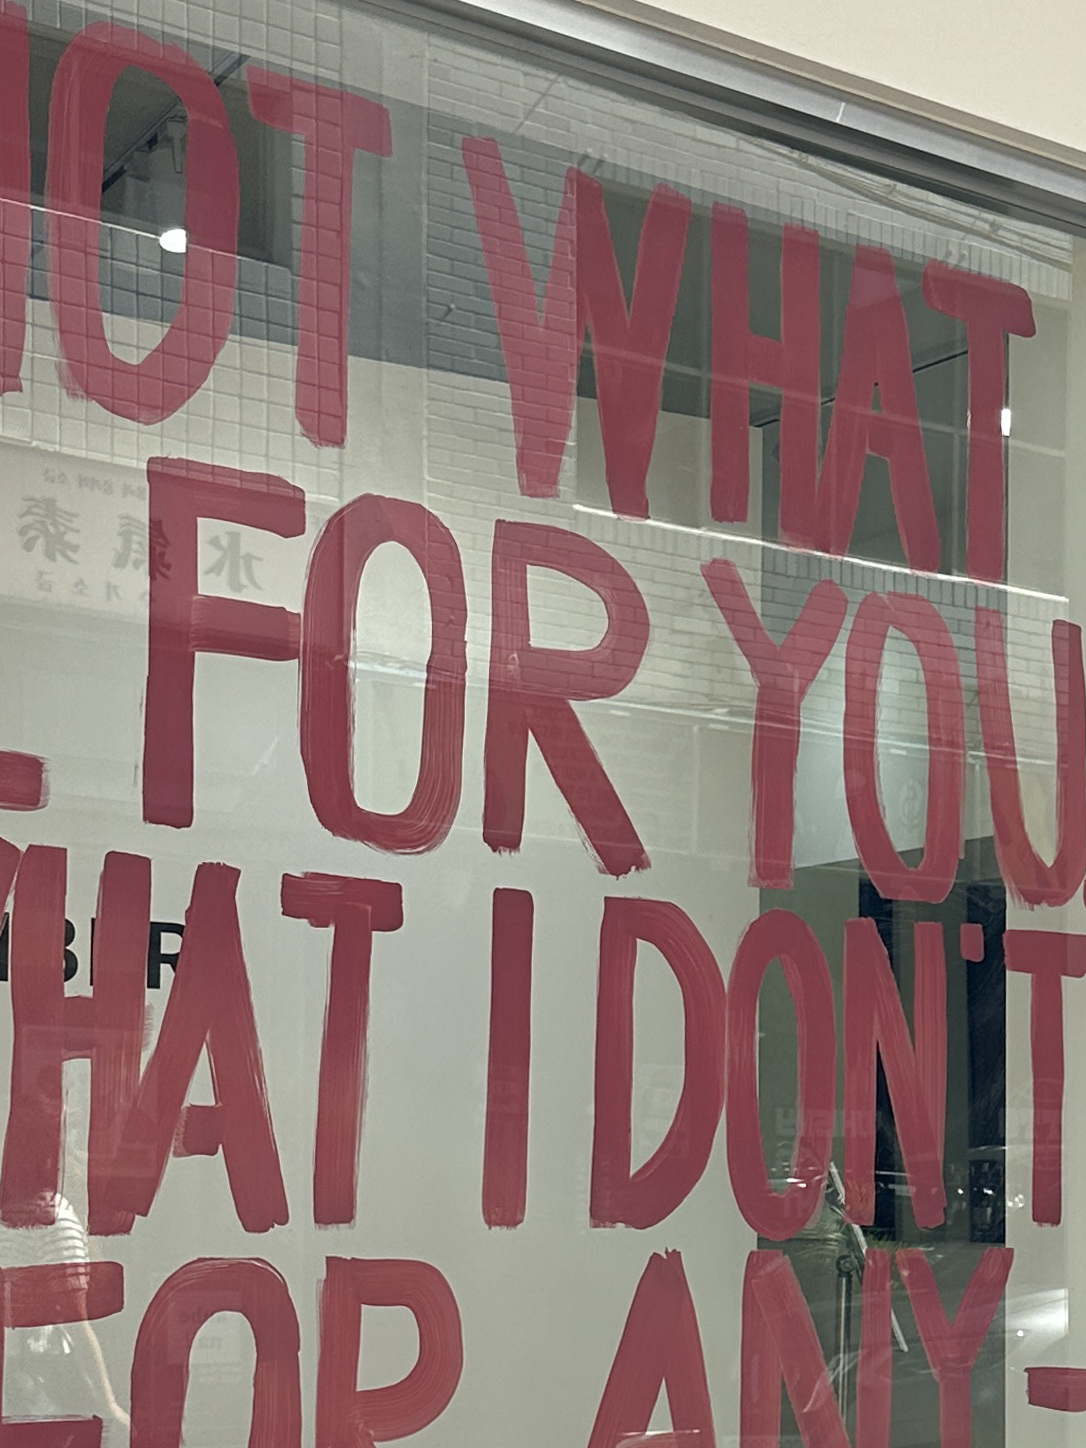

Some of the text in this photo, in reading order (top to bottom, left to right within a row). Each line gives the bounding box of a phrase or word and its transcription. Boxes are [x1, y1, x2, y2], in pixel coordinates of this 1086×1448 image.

[462, 137, 1036, 584] WHAT
[143, 456, 651, 879] FOR
[481, 888, 534, 1230] I
